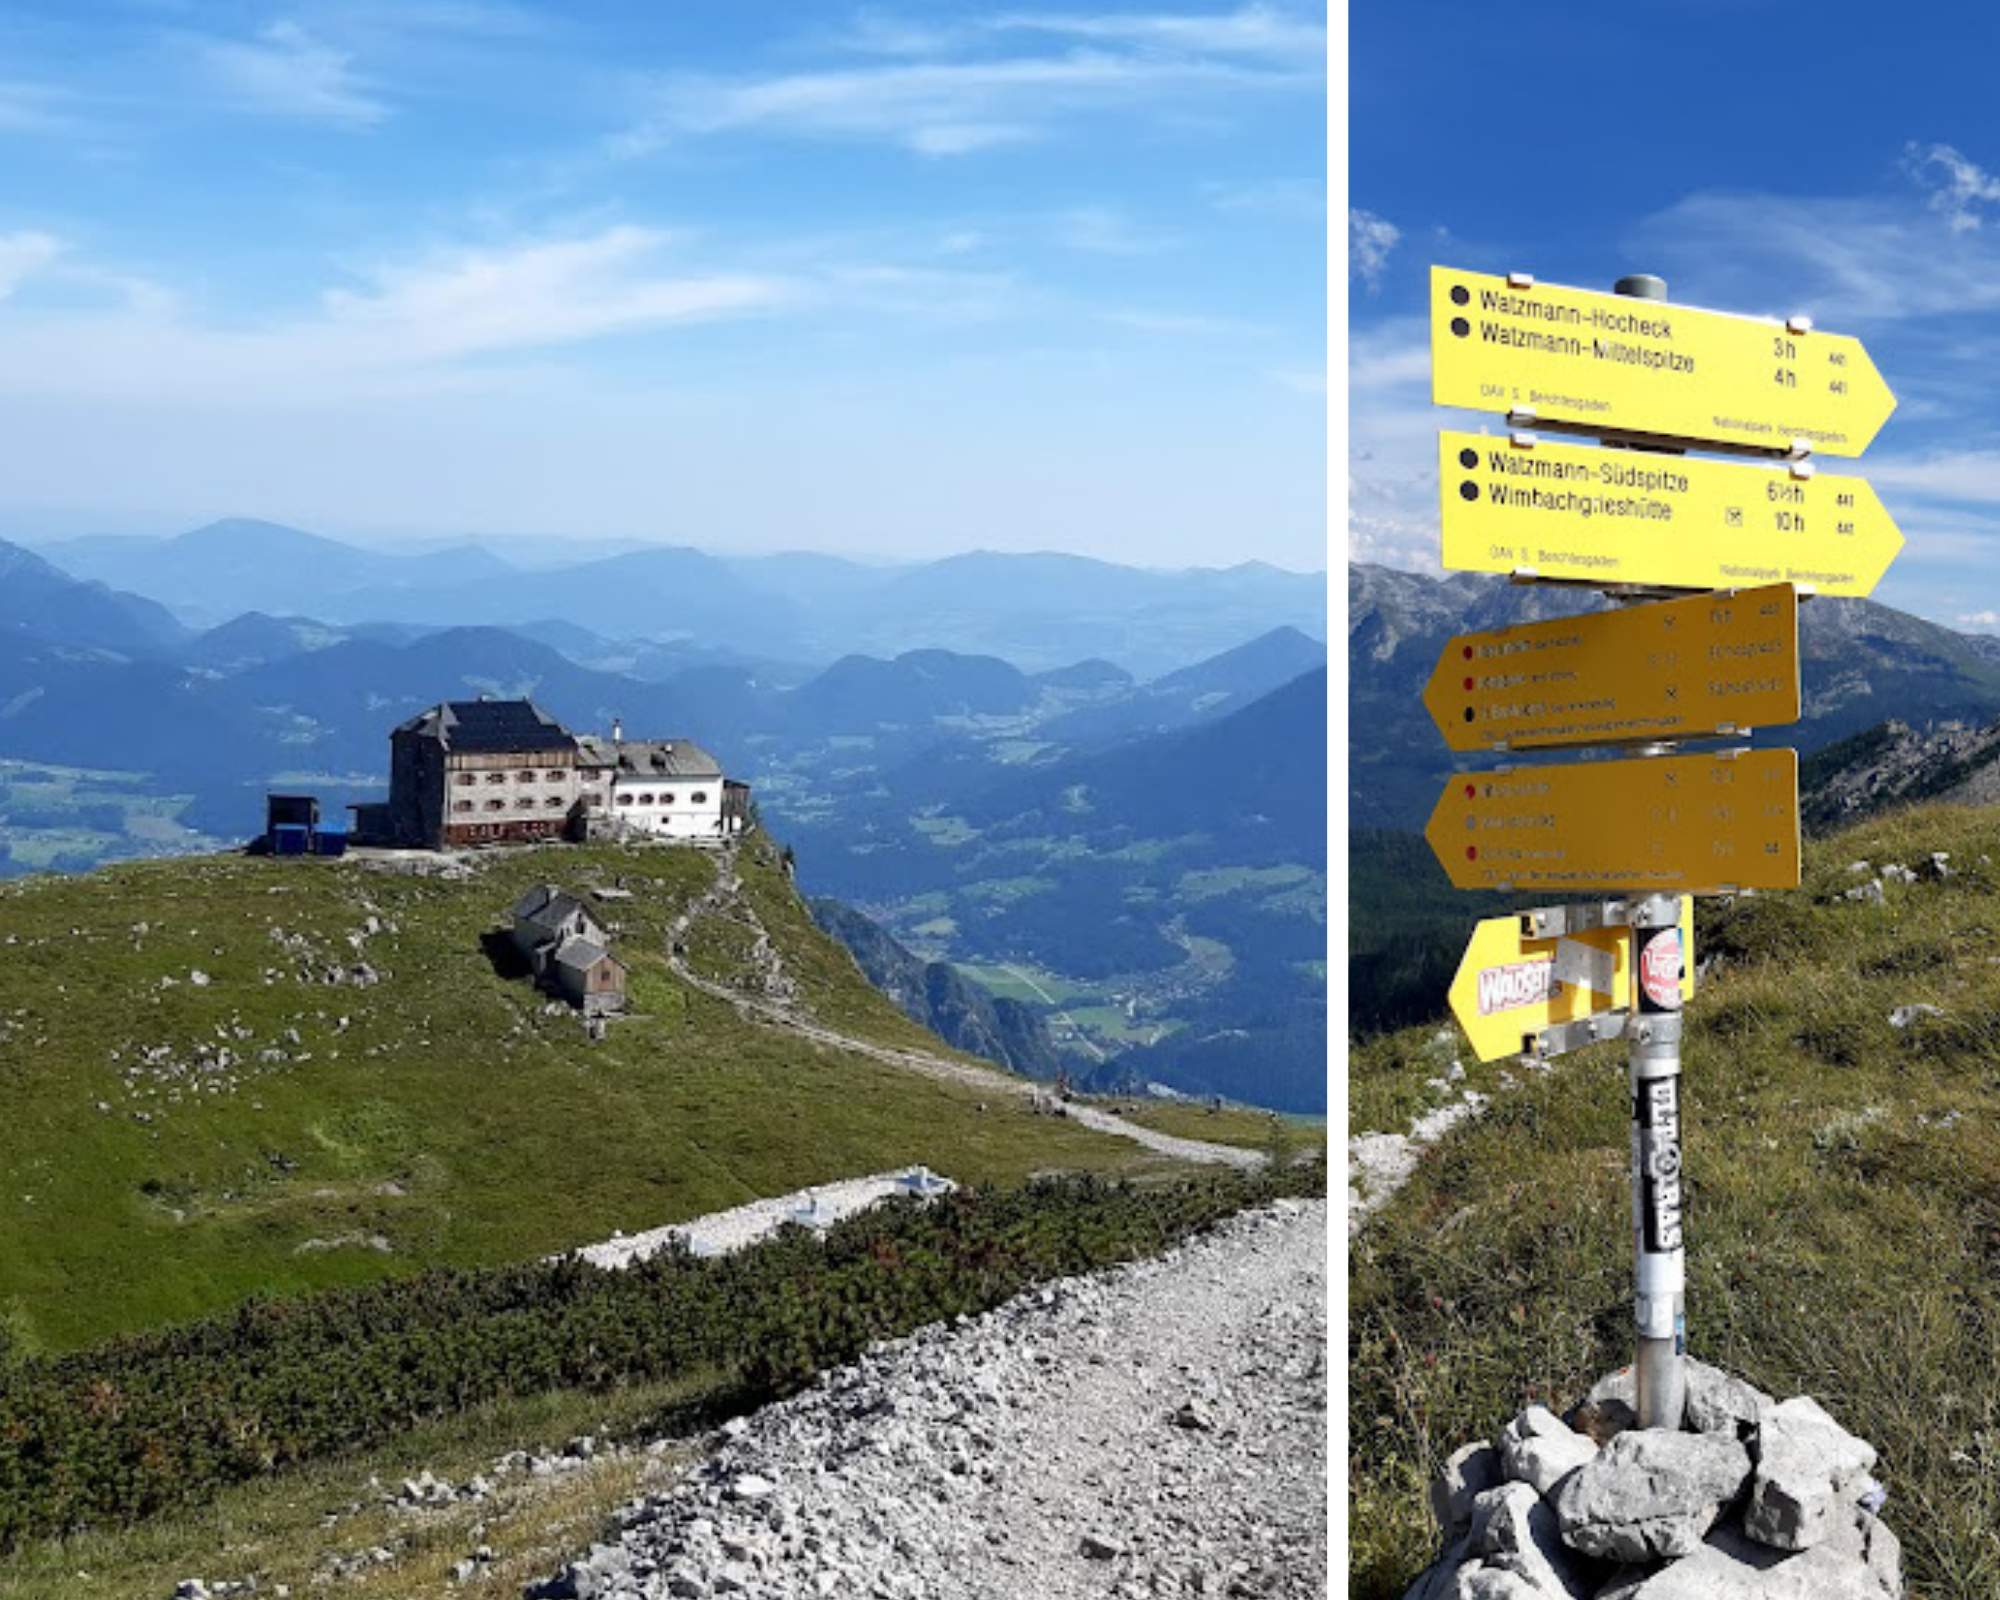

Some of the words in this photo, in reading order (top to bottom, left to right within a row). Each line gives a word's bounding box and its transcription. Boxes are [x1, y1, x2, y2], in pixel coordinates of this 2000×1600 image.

[1479, 289, 1672, 339] Watzmann-Hocheck
[1480, 320, 1694, 373] Watzmann-Mittelspitze
[1487, 450, 1689, 493] Watzmann-Südspitze
[1488, 482, 1673, 521] Wimbachgrieshütte
